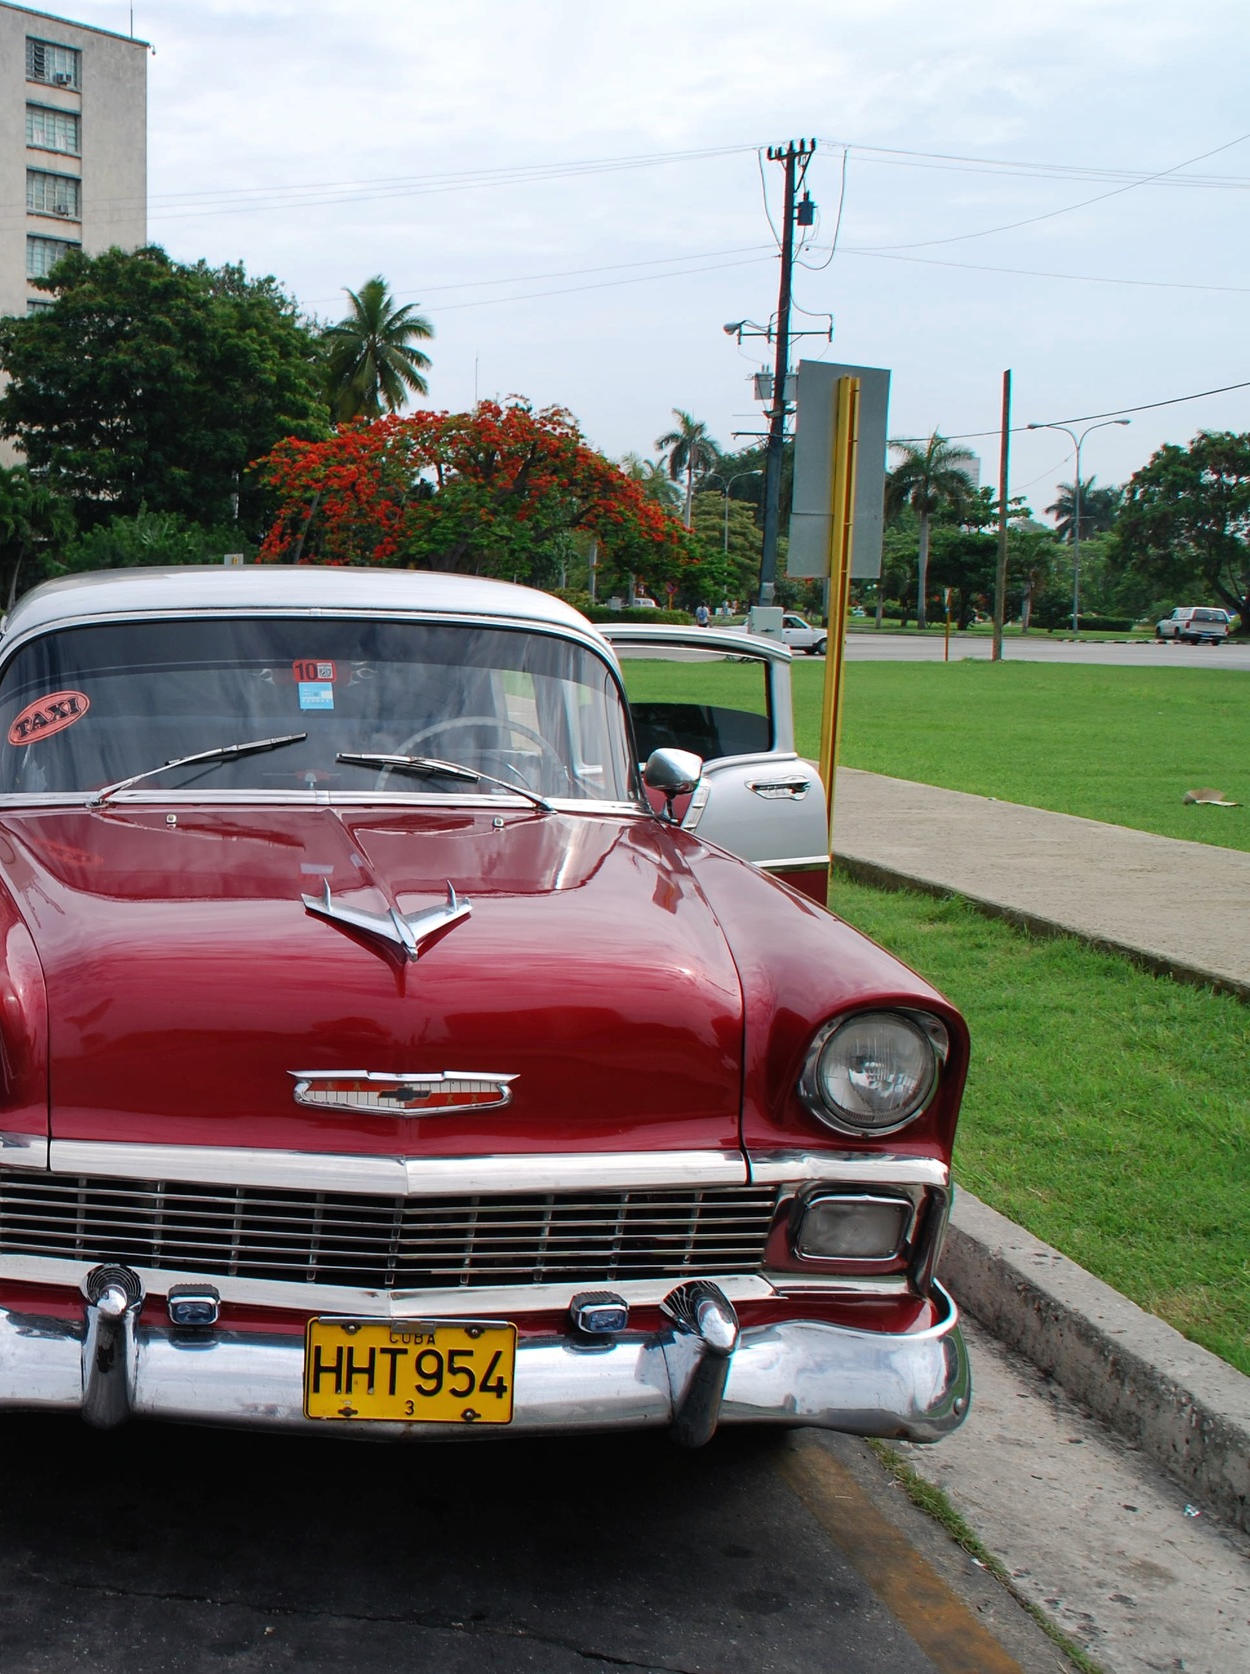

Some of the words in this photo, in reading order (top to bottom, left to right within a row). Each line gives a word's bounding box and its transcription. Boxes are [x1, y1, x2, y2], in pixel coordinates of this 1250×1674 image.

[295, 662, 318, 680] 10
[14, 696, 81, 739] TAXI
[389, 1331, 436, 1345] CUBA
[312, 1345, 508, 1399] HHT954
[404, 1400, 415, 1416] 3
